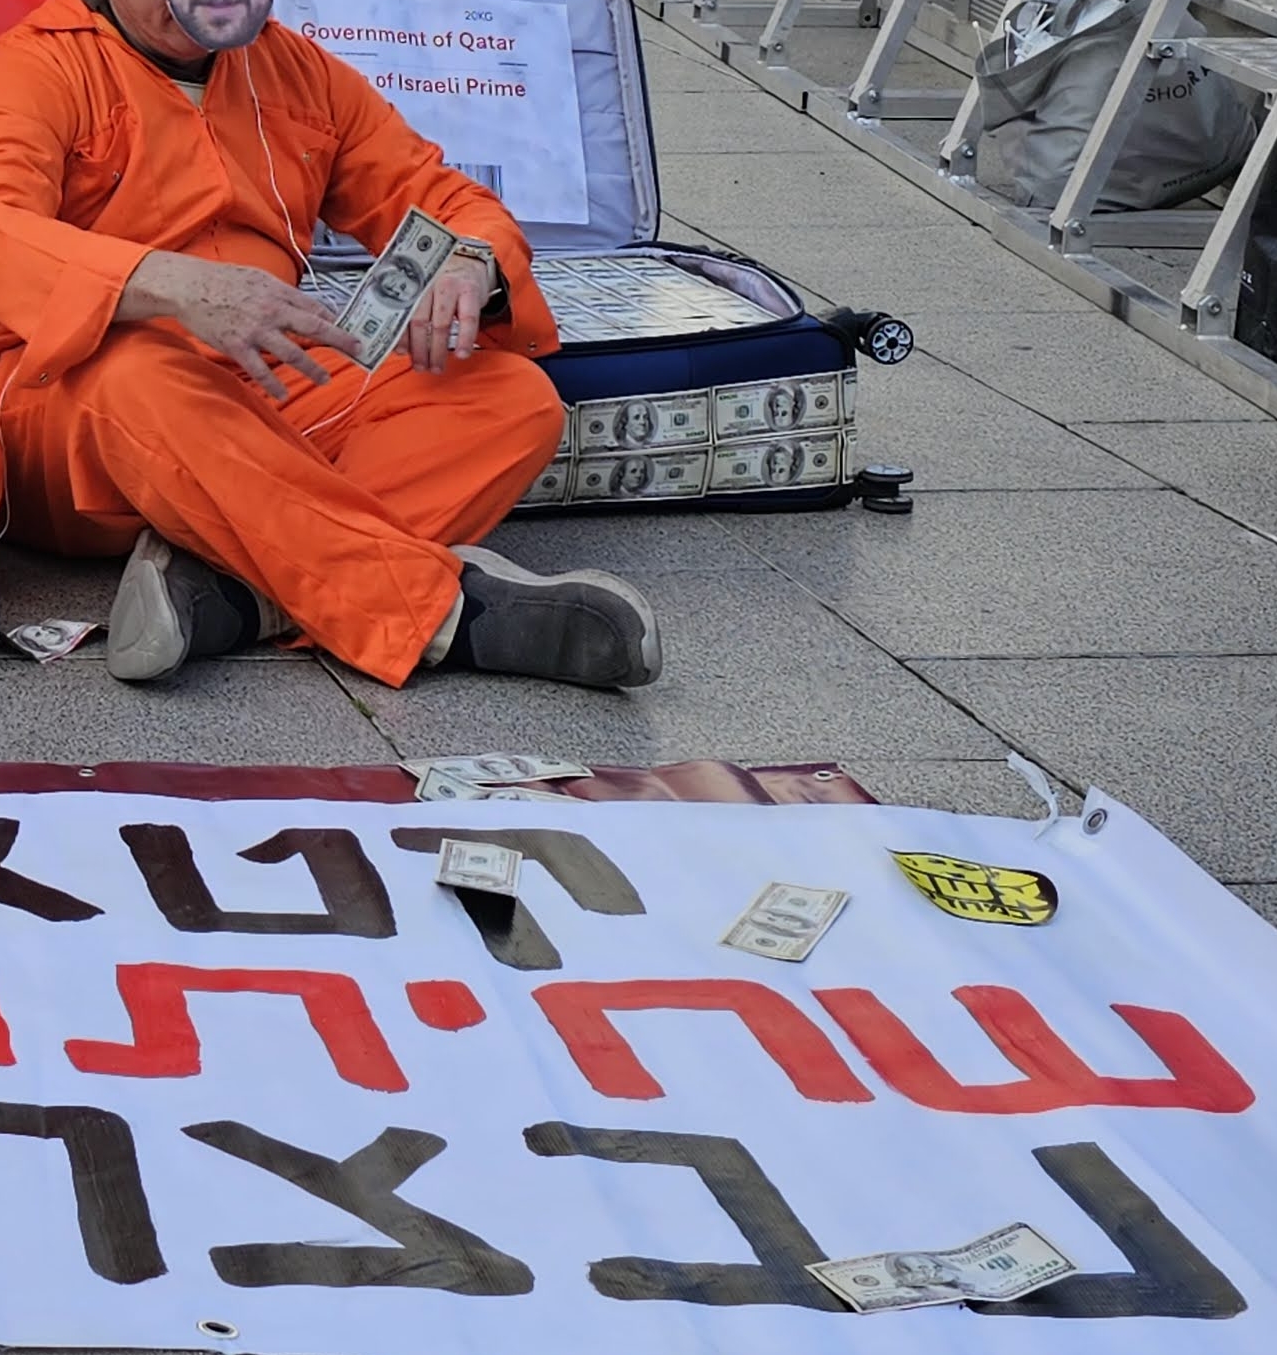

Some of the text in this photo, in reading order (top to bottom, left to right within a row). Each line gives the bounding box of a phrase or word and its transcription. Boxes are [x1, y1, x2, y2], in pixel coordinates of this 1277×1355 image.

[465, 10, 493, 22] 20KG
[301, 22, 516, 52] Government of Qatar
[376, 73, 526, 97] of Israeli Prime
